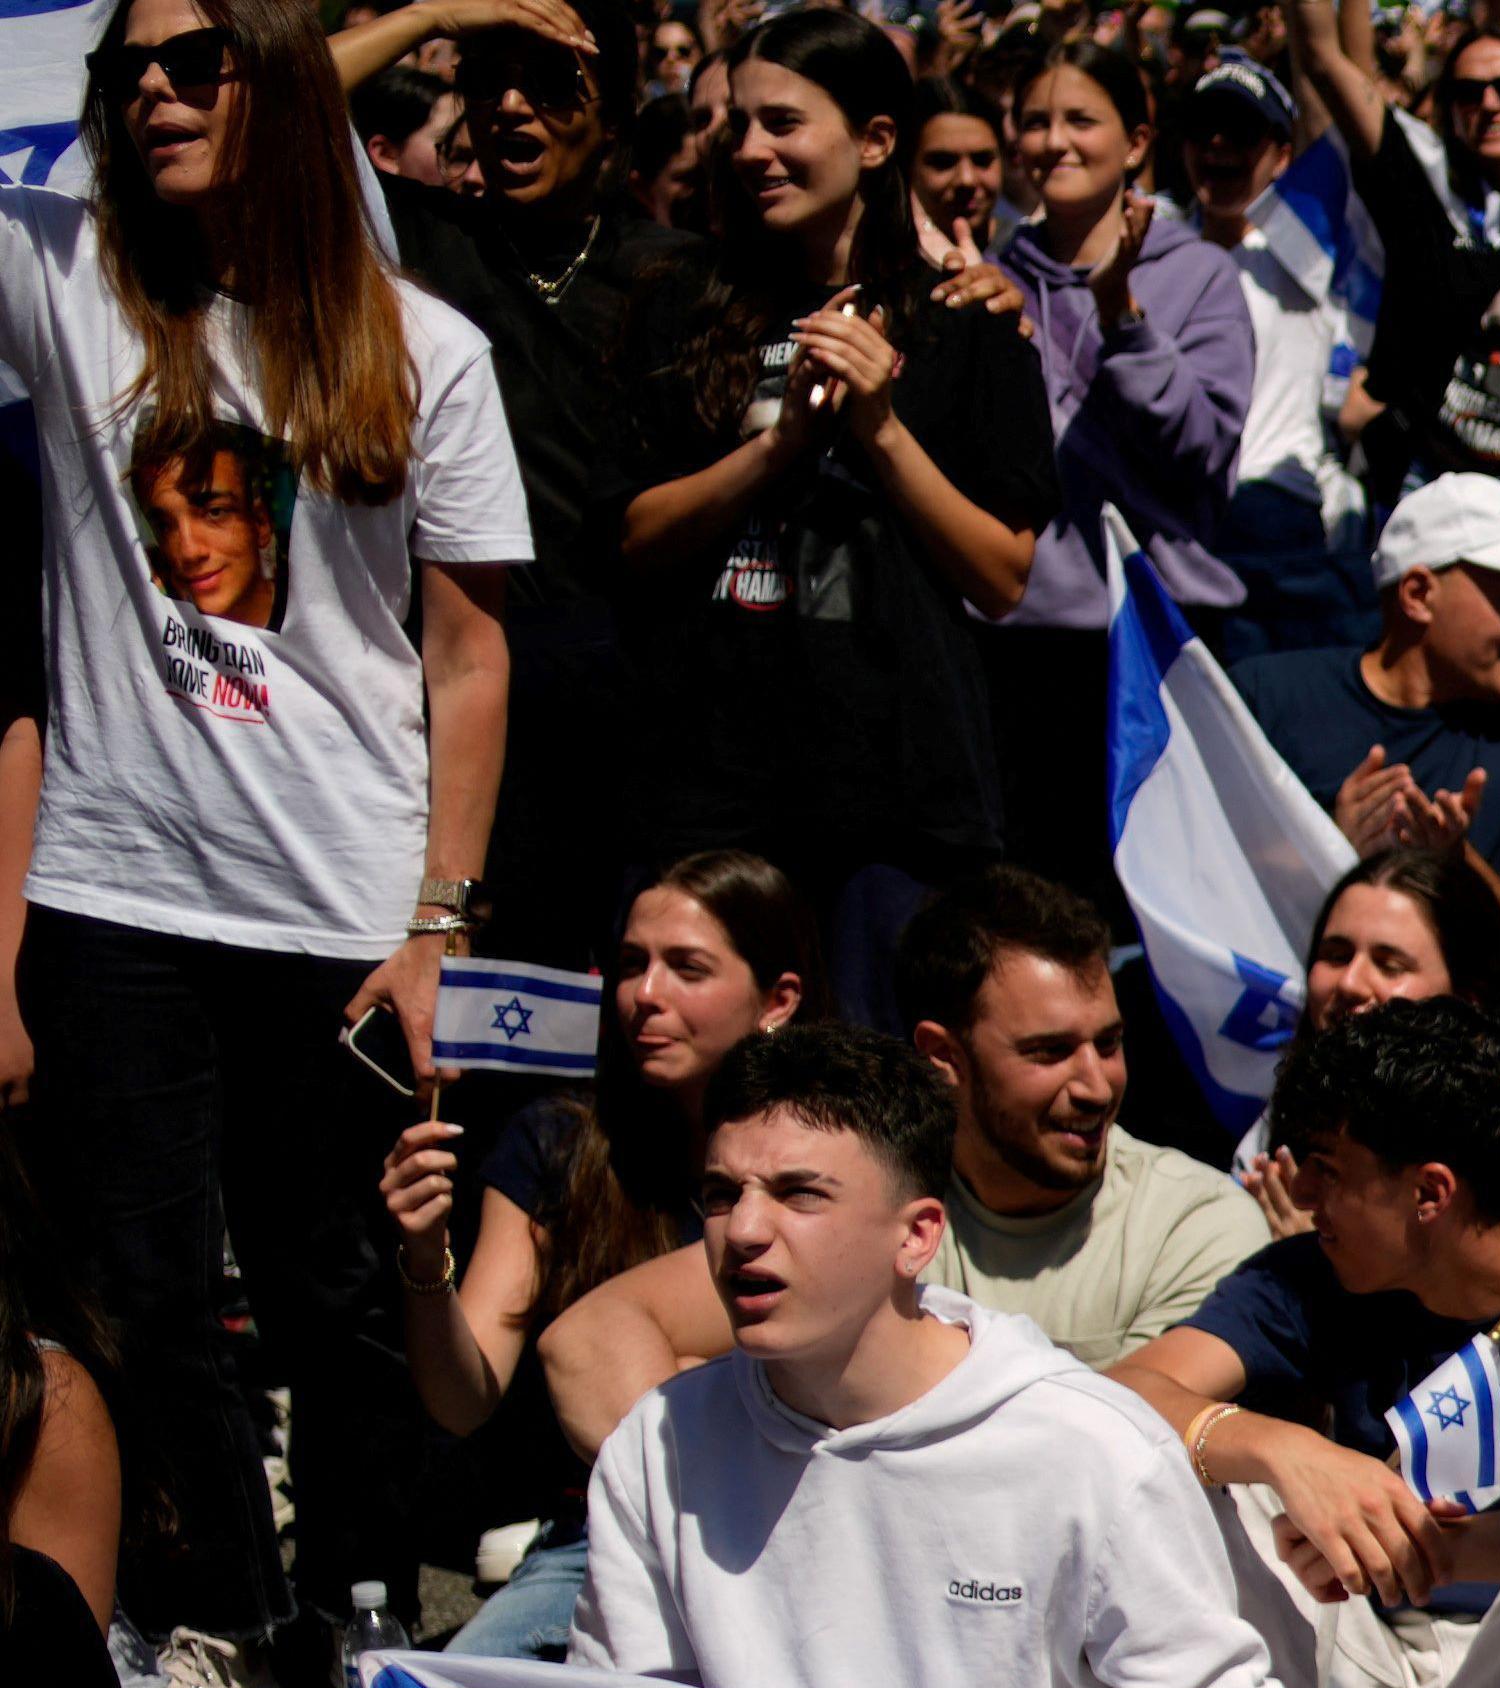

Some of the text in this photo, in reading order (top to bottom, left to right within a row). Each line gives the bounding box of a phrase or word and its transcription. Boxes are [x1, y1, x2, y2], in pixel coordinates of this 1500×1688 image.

[163, 616, 222, 663] BRING
[212, 672, 270, 717] NOW!
[949, 1580, 1023, 1602] adidas
